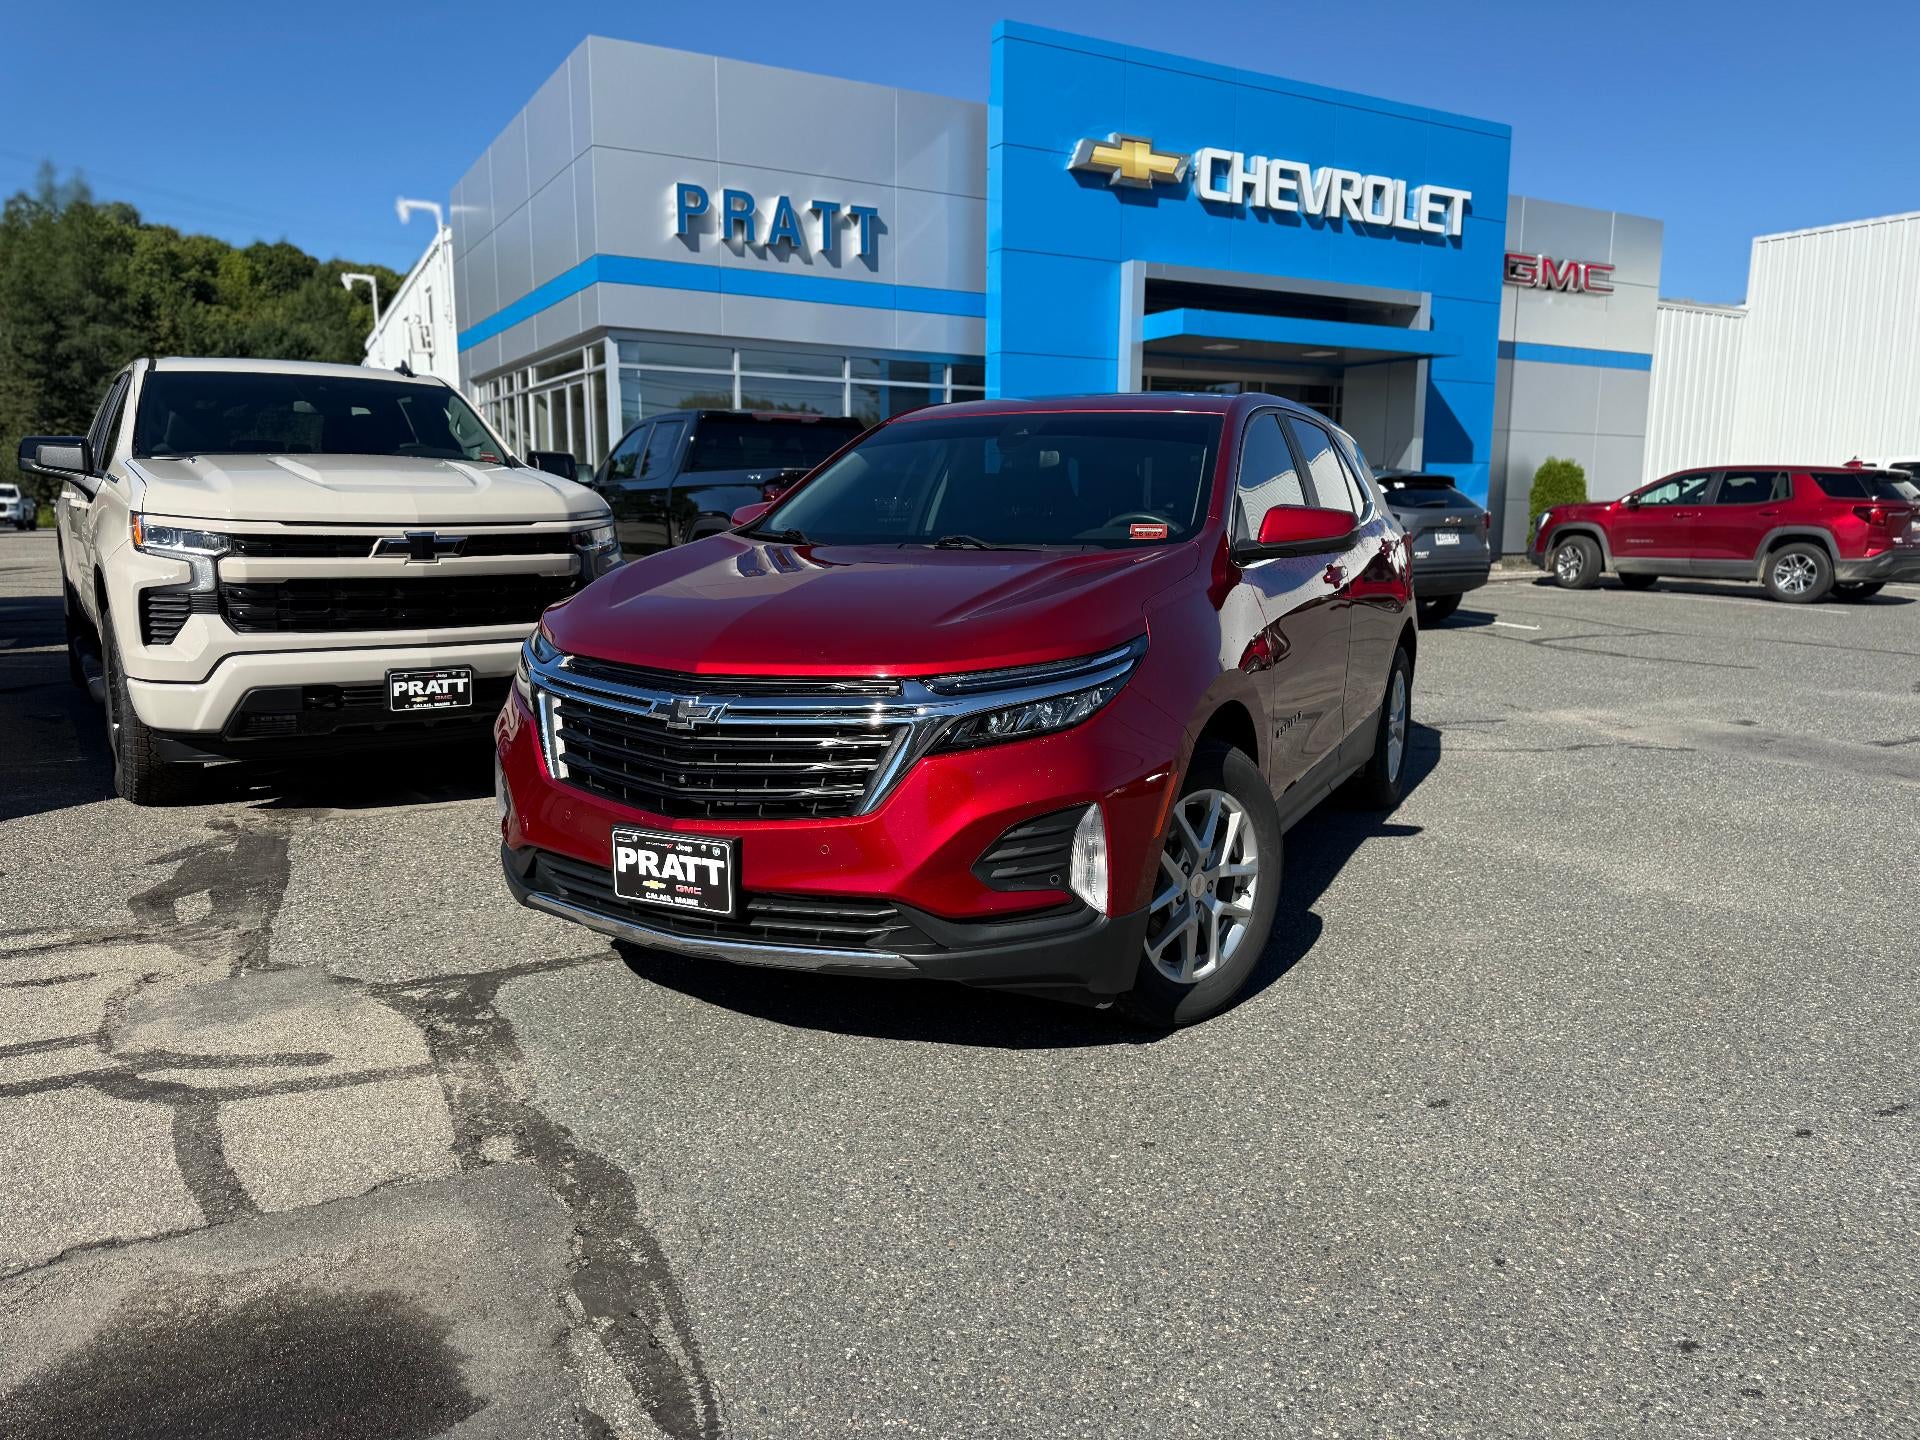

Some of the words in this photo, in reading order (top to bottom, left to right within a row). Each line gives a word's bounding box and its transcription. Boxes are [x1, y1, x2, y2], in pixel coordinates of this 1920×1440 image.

[1195, 147, 1472, 236] CHEVROLET
[674, 182, 878, 256] PRATT
[1503, 253, 1615, 294] GMC
[393, 678, 469, 697] PRATT
[675, 843, 693, 853] Jeep
[616, 846, 725, 886] PRATT
[674, 896, 699, 906] MAINE
[675, 884, 702, 895] GMC
